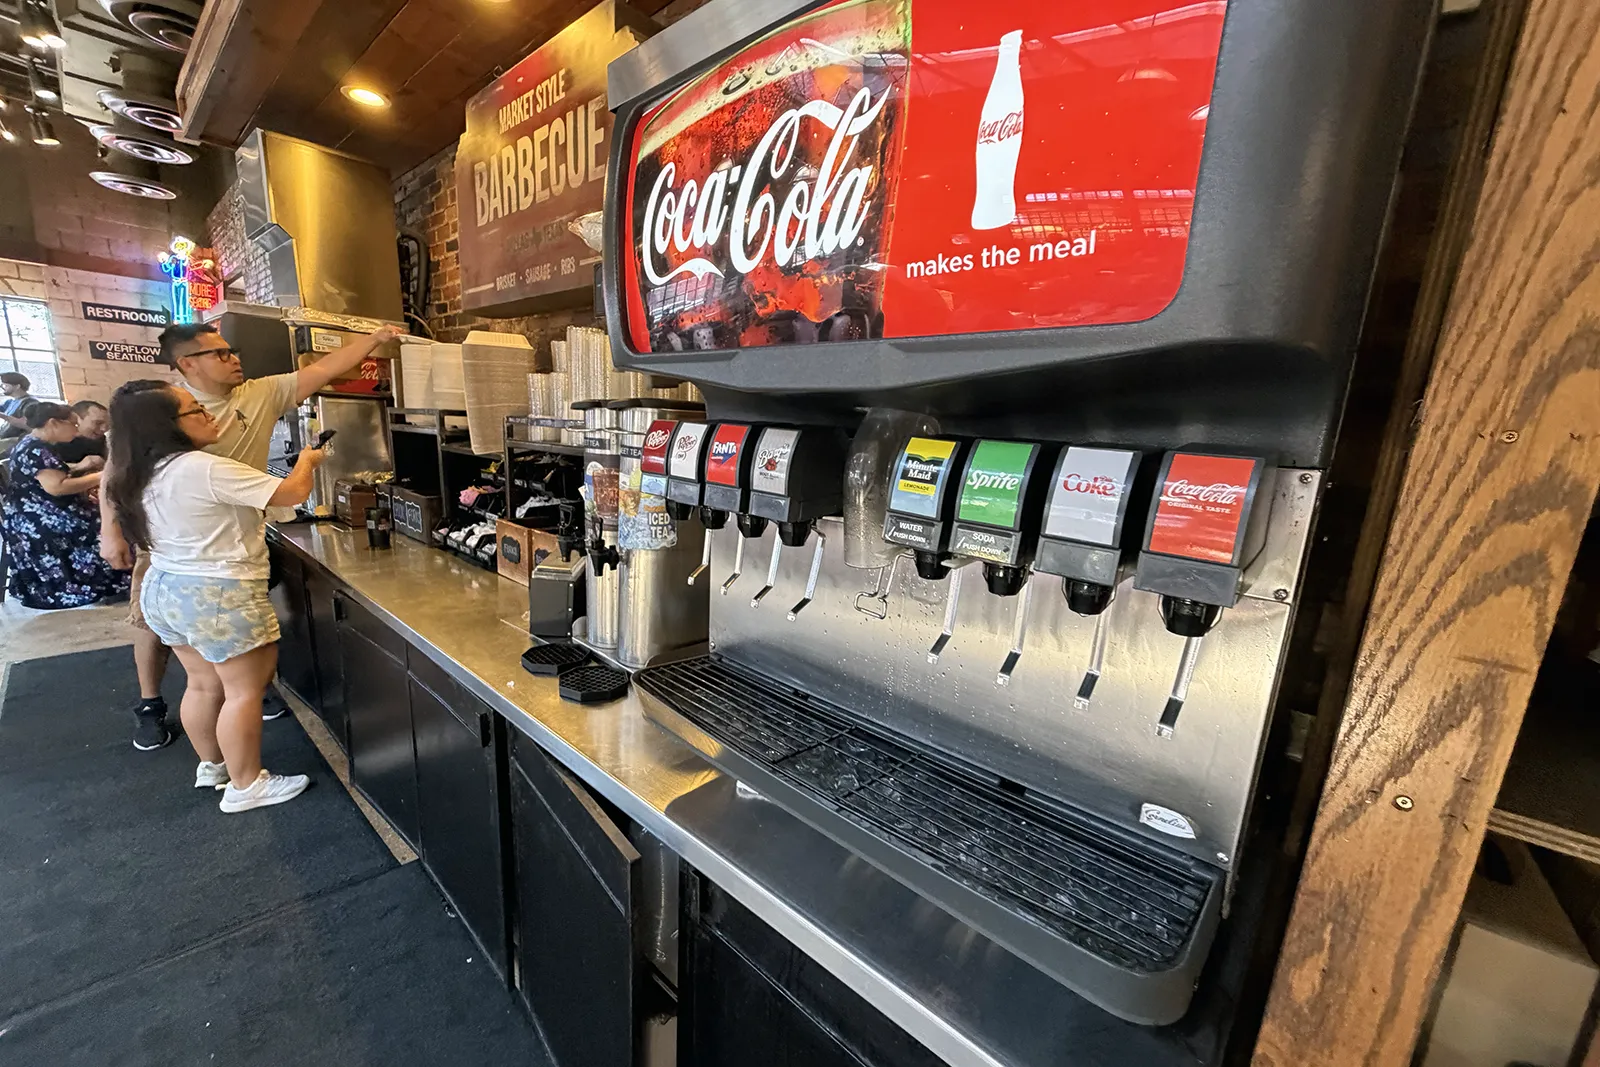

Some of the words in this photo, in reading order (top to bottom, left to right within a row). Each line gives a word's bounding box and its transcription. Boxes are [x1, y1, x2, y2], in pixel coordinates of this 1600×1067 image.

[499, 88, 534, 135] MARKET
[535, 68, 567, 114] STYLE
[474, 93, 606, 227] BARBECUE
[642, 82, 892, 286] Coca-Cola
[906, 253, 974, 278] makes
[982, 245, 1020, 268] the
[1029, 229, 1097, 262] meal
[496, 272, 516, 291] BRISKET
[525, 263, 551, 284] SAUSAGE
[561, 256, 575, 275] RIBS
[86, 307, 167, 325] RESTROOMS
[96, 341, 161, 357] OVERFLOW
[106, 350, 155, 364] SEATING
[712, 441, 737, 454] FANTA
[907, 459, 938, 473] Minute
[908, 469, 931, 481] Maid
[966, 469, 1019, 490] Sprite
[903, 482, 930, 491] LEMONADE
[1063, 473, 1116, 497] Coke
[1166, 479, 1237, 505] Coca-Cola
[1167, 501, 1203, 511] ORIGINAL
[1206, 505, 1231, 514] TASTE
[649, 513, 670, 525] ICED
[650, 526, 668, 538] TEA
[900, 522, 923, 533] WATER
[893, 532, 908, 541] PUSH
[909, 535, 926, 543] DOWN
[972, 533, 995, 543] SODA
[963, 542, 980, 552] PUSH
[981, 546, 1002, 556] DOWN
